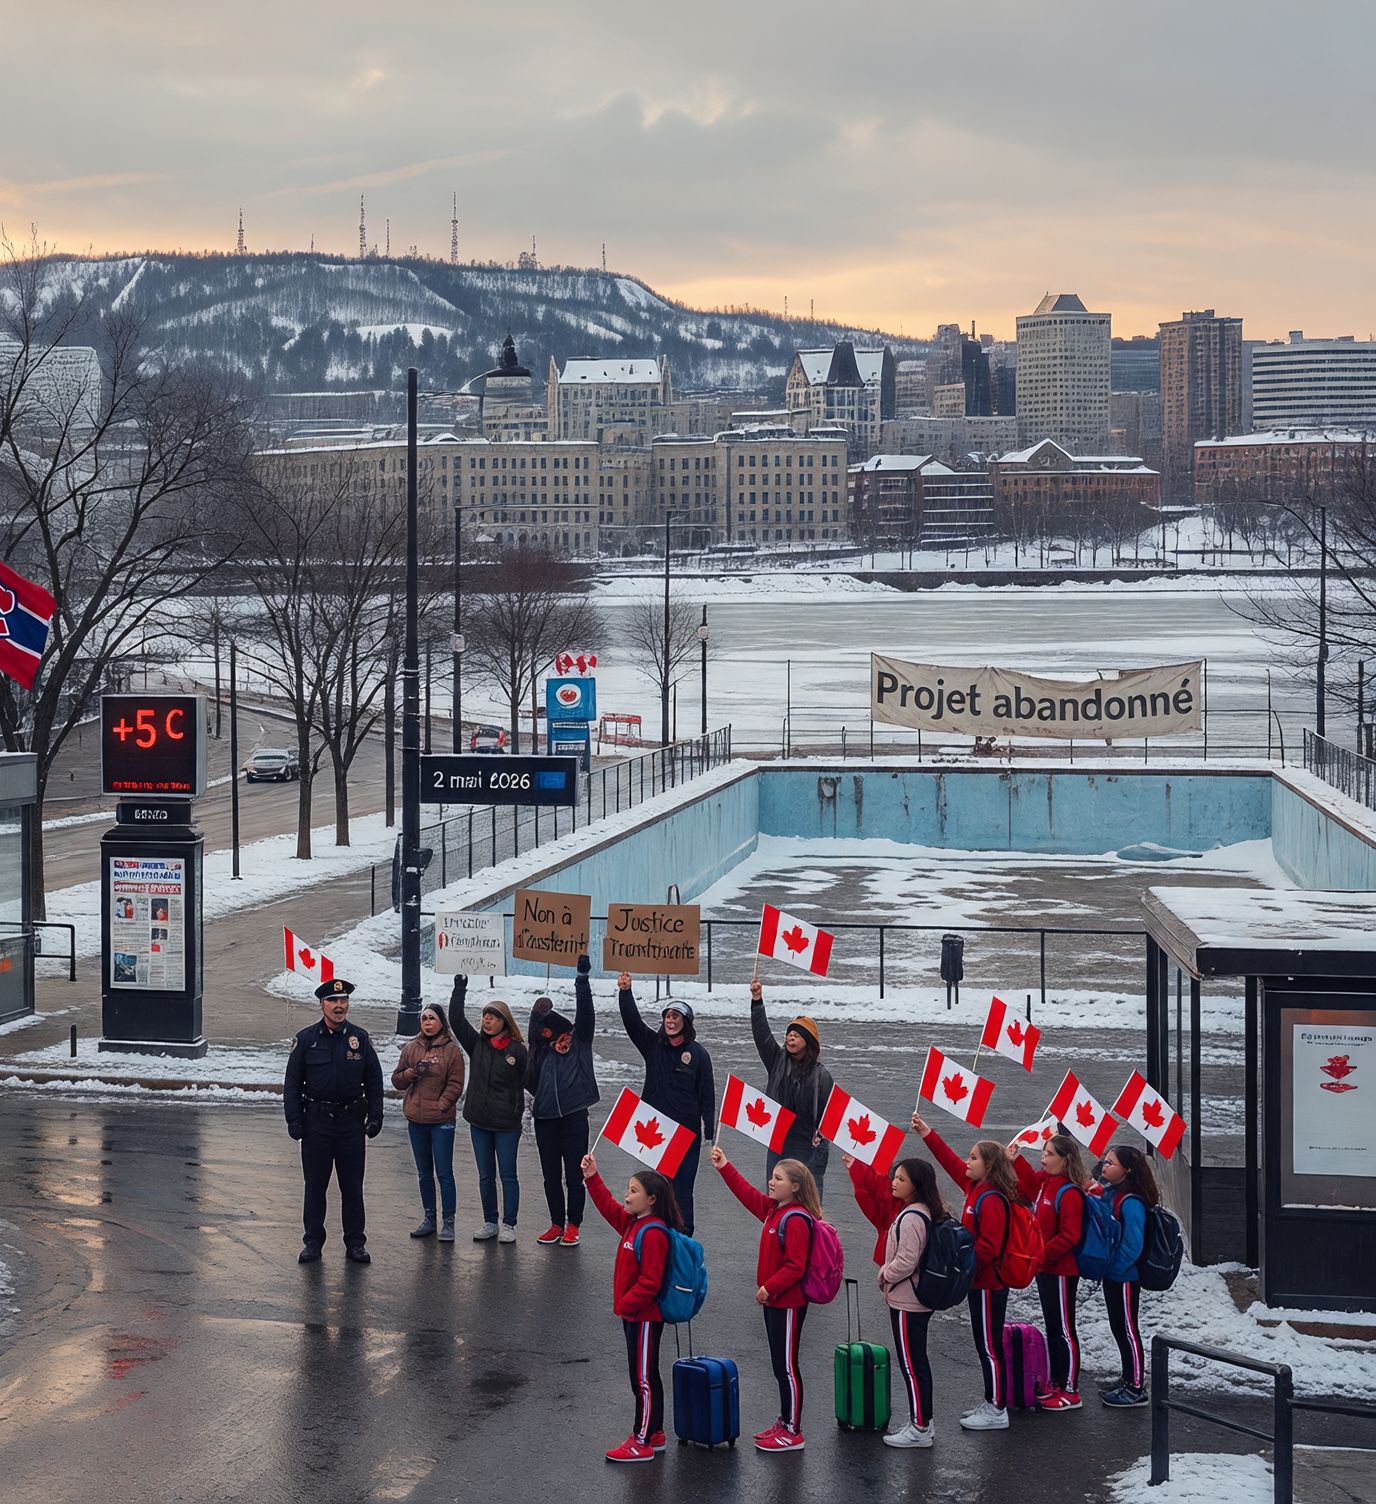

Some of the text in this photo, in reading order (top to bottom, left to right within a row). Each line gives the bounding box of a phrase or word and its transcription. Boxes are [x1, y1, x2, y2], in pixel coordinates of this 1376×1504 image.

[877, 670, 1193, 722] Projet abandonné
[433, 770, 445, 788] 2
[523, 897, 573, 926] Non à
[614, 908, 684, 934] Justice
